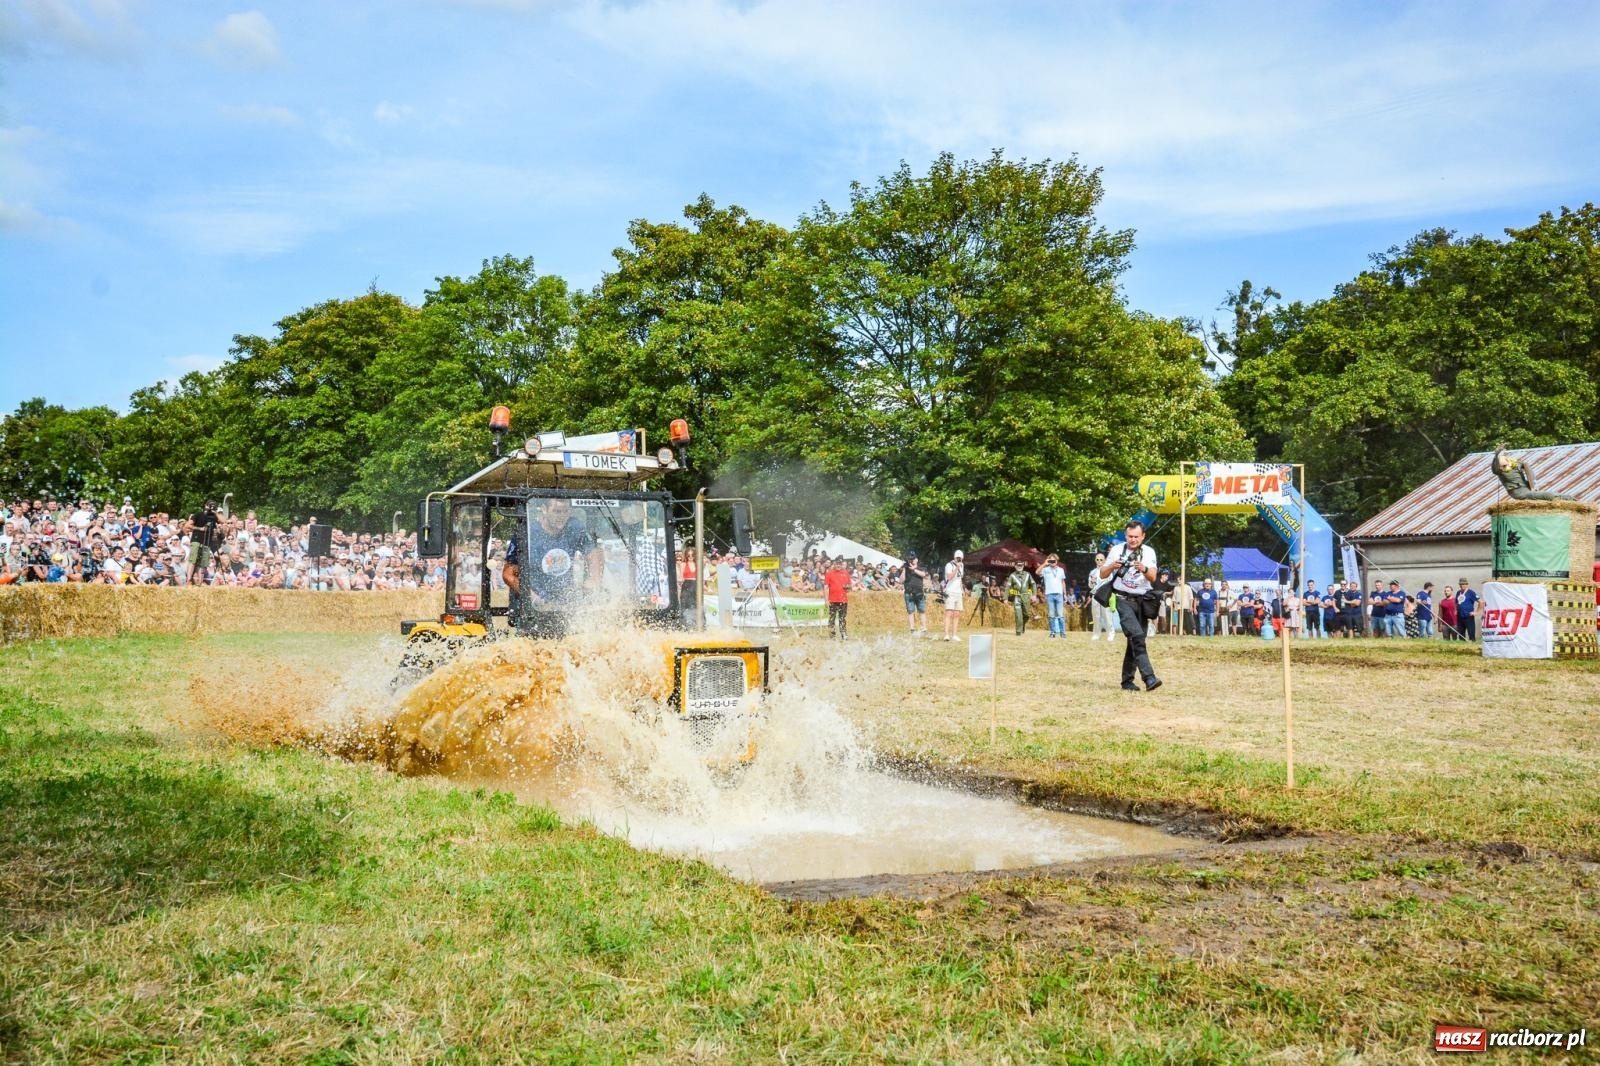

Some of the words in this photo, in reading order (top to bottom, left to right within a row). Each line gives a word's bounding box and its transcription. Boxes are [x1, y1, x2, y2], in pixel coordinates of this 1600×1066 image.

[582, 454, 627, 470] TOMEK
[1213, 475, 1280, 495] META
[1282, 511, 1302, 532] ludzi
